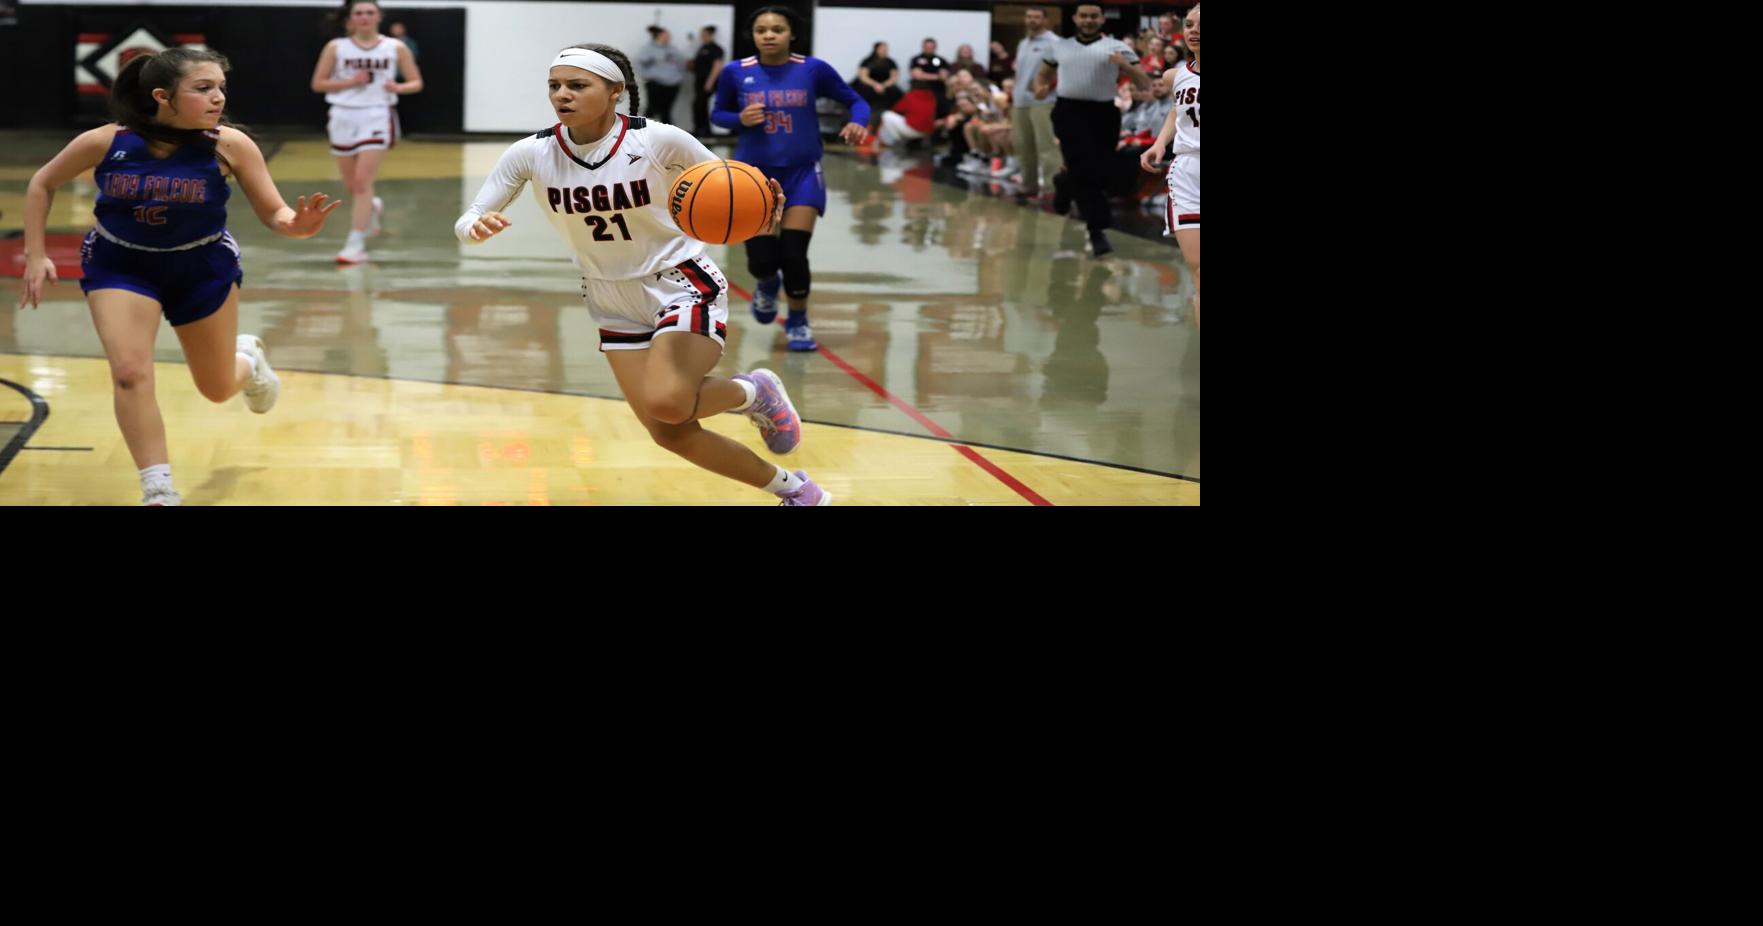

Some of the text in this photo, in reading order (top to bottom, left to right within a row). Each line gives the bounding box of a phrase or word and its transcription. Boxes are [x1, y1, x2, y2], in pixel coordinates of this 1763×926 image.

[764, 110, 793, 134] 34
[1186, 107, 1200, 128] 1
[547, 179, 652, 215] PISGAH
[583, 213, 633, 242] 21
